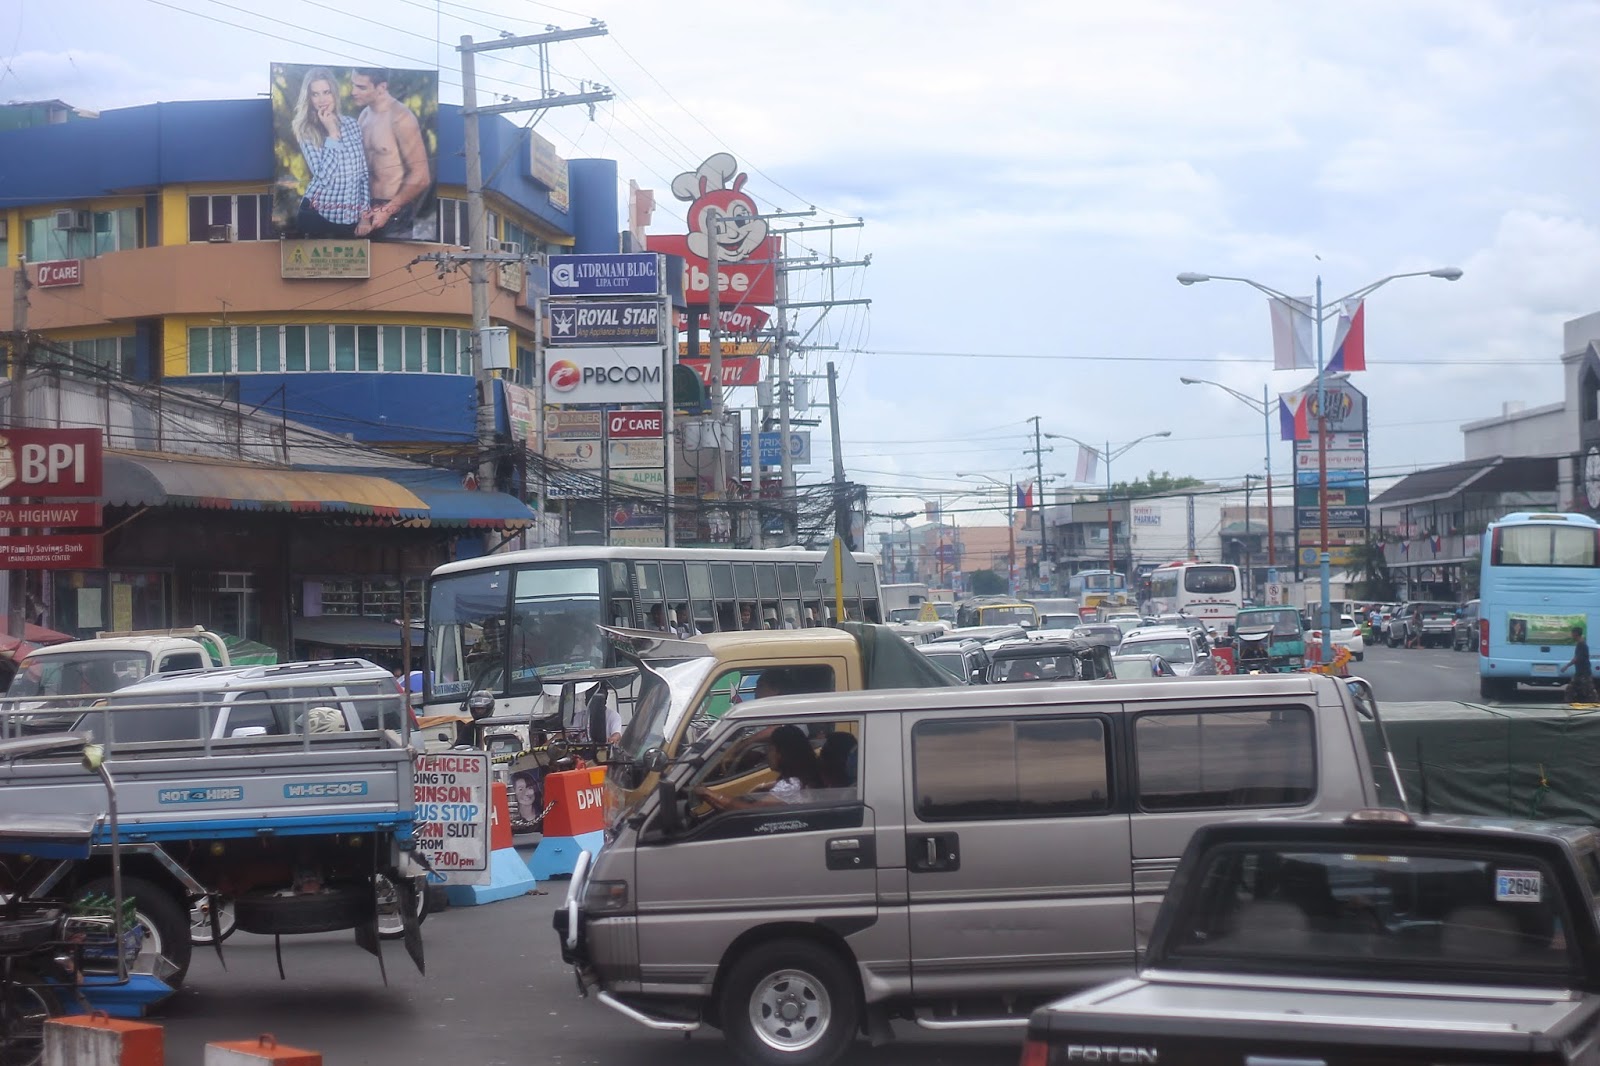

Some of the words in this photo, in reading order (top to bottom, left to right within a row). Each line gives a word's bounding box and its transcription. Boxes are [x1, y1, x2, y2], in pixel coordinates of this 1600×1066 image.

[311, 246, 366, 258] ALPHA
[53, 266, 78, 280] CARE
[576, 262, 625, 278] ATDRMAM
[627, 261, 656, 277] BLDG.
[595, 278, 612, 287] LIPA
[613, 278, 630, 287] CITY
[577, 308, 619, 326] ROYAL
[622, 308, 657, 325] STAR
[589, 328, 616, 336] Appliance
[617, 327, 631, 335] Store
[583, 366, 660, 384] PBCOM
[629, 419, 660, 430] CARE
[21, 443, 85, 484] BPI
[633, 472, 663, 483] ALPHA
[19, 510, 79, 522] HIGHWAY
[11, 545, 34, 555] Family
[36, 543, 63, 555] Savings
[65, 543, 83, 553] Bank
[415, 758, 480, 773] VEHICLES
[441, 773, 456, 784] TO
[161, 791, 190, 801] NOT
[206, 788, 240, 800] HIRE
[441, 804, 479, 821] STOP
[447, 823, 477, 838] SLOT
[415, 839, 444, 849] FROM
[1508, 877, 1539, 896] 2694
[1067, 1045, 1158, 1063] FOTON
